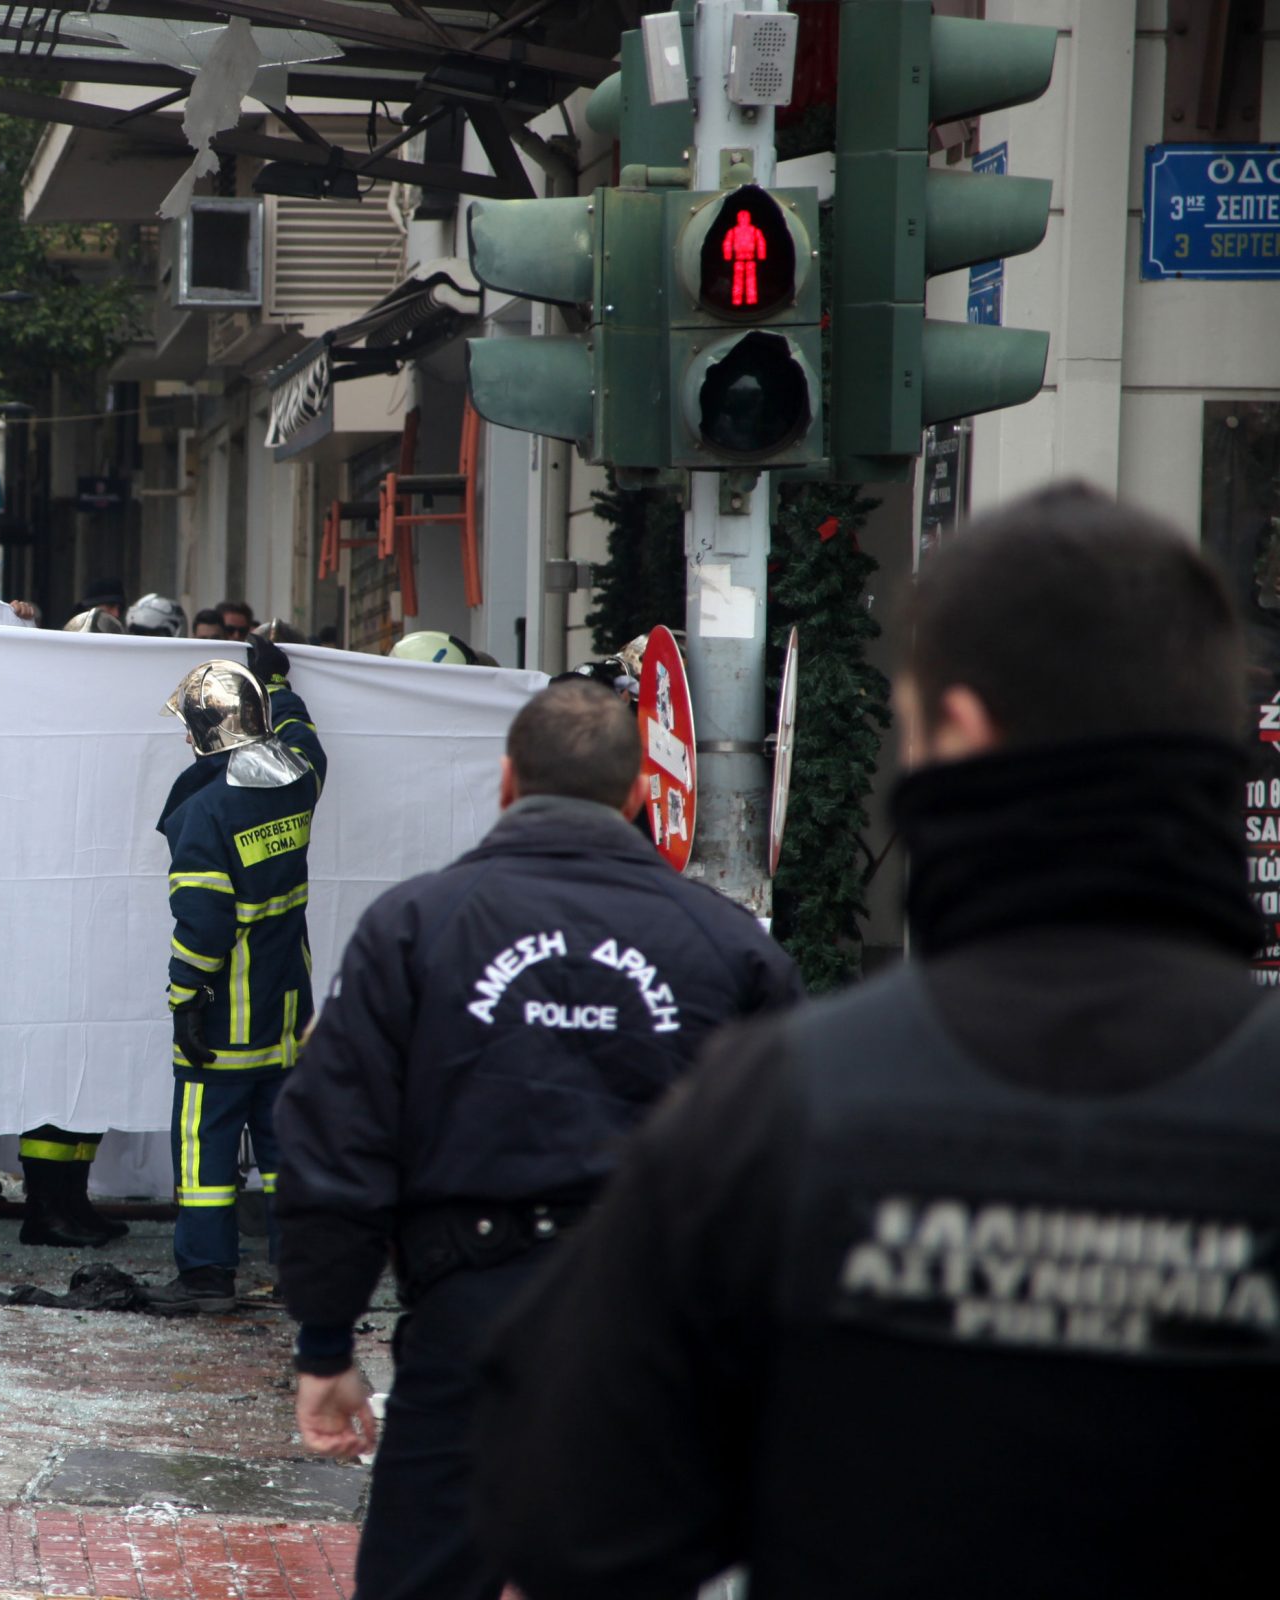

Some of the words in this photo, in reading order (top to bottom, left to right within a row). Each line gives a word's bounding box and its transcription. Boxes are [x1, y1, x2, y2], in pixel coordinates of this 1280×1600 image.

[1174, 233, 1190, 258] 3
[265, 836, 297, 855] ΣΩΜΑ
[467, 929, 568, 1025] ΑΜΕΣΗ
[590, 938, 681, 1033] ΔΡΑΣΗ
[524, 1001, 618, 1030] POLICE
